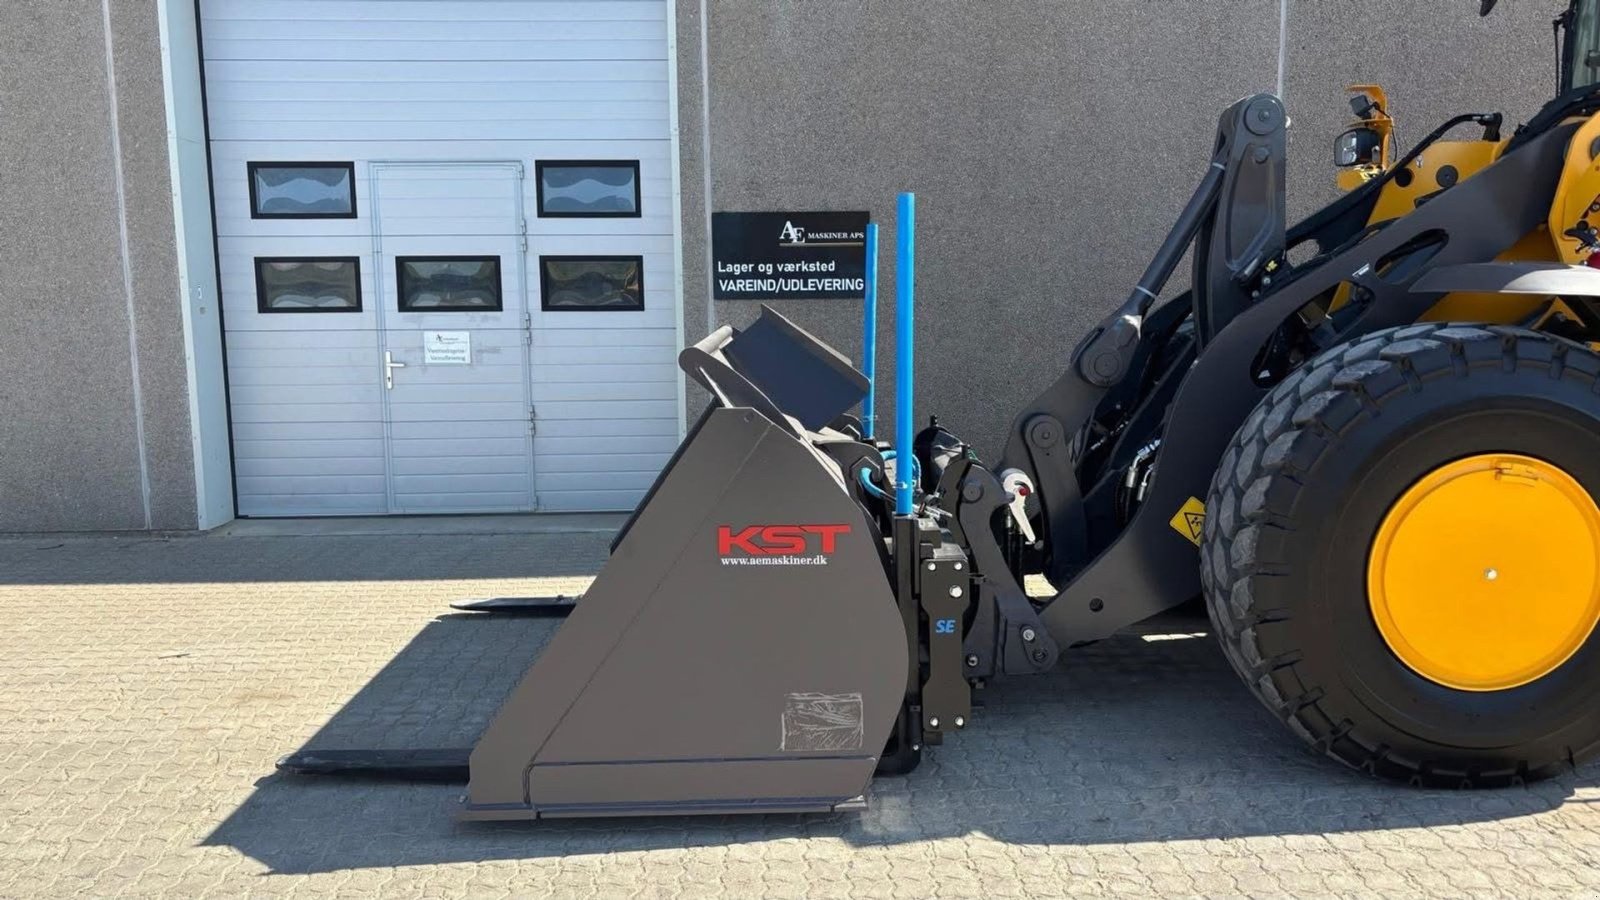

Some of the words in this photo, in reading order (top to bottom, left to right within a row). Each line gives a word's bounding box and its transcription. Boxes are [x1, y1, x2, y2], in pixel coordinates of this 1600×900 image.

[779, 220, 806, 244] AE
[718, 260, 755, 275] Lager
[758, 263, 773, 275] og
[776, 260, 836, 272] værksted
[719, 277, 865, 293] VAREIND/UDLEVERING
[718, 525, 852, 555] KST
[721, 555, 828, 565] www.aemaskiner.dk
[935, 619, 956, 633] SE
